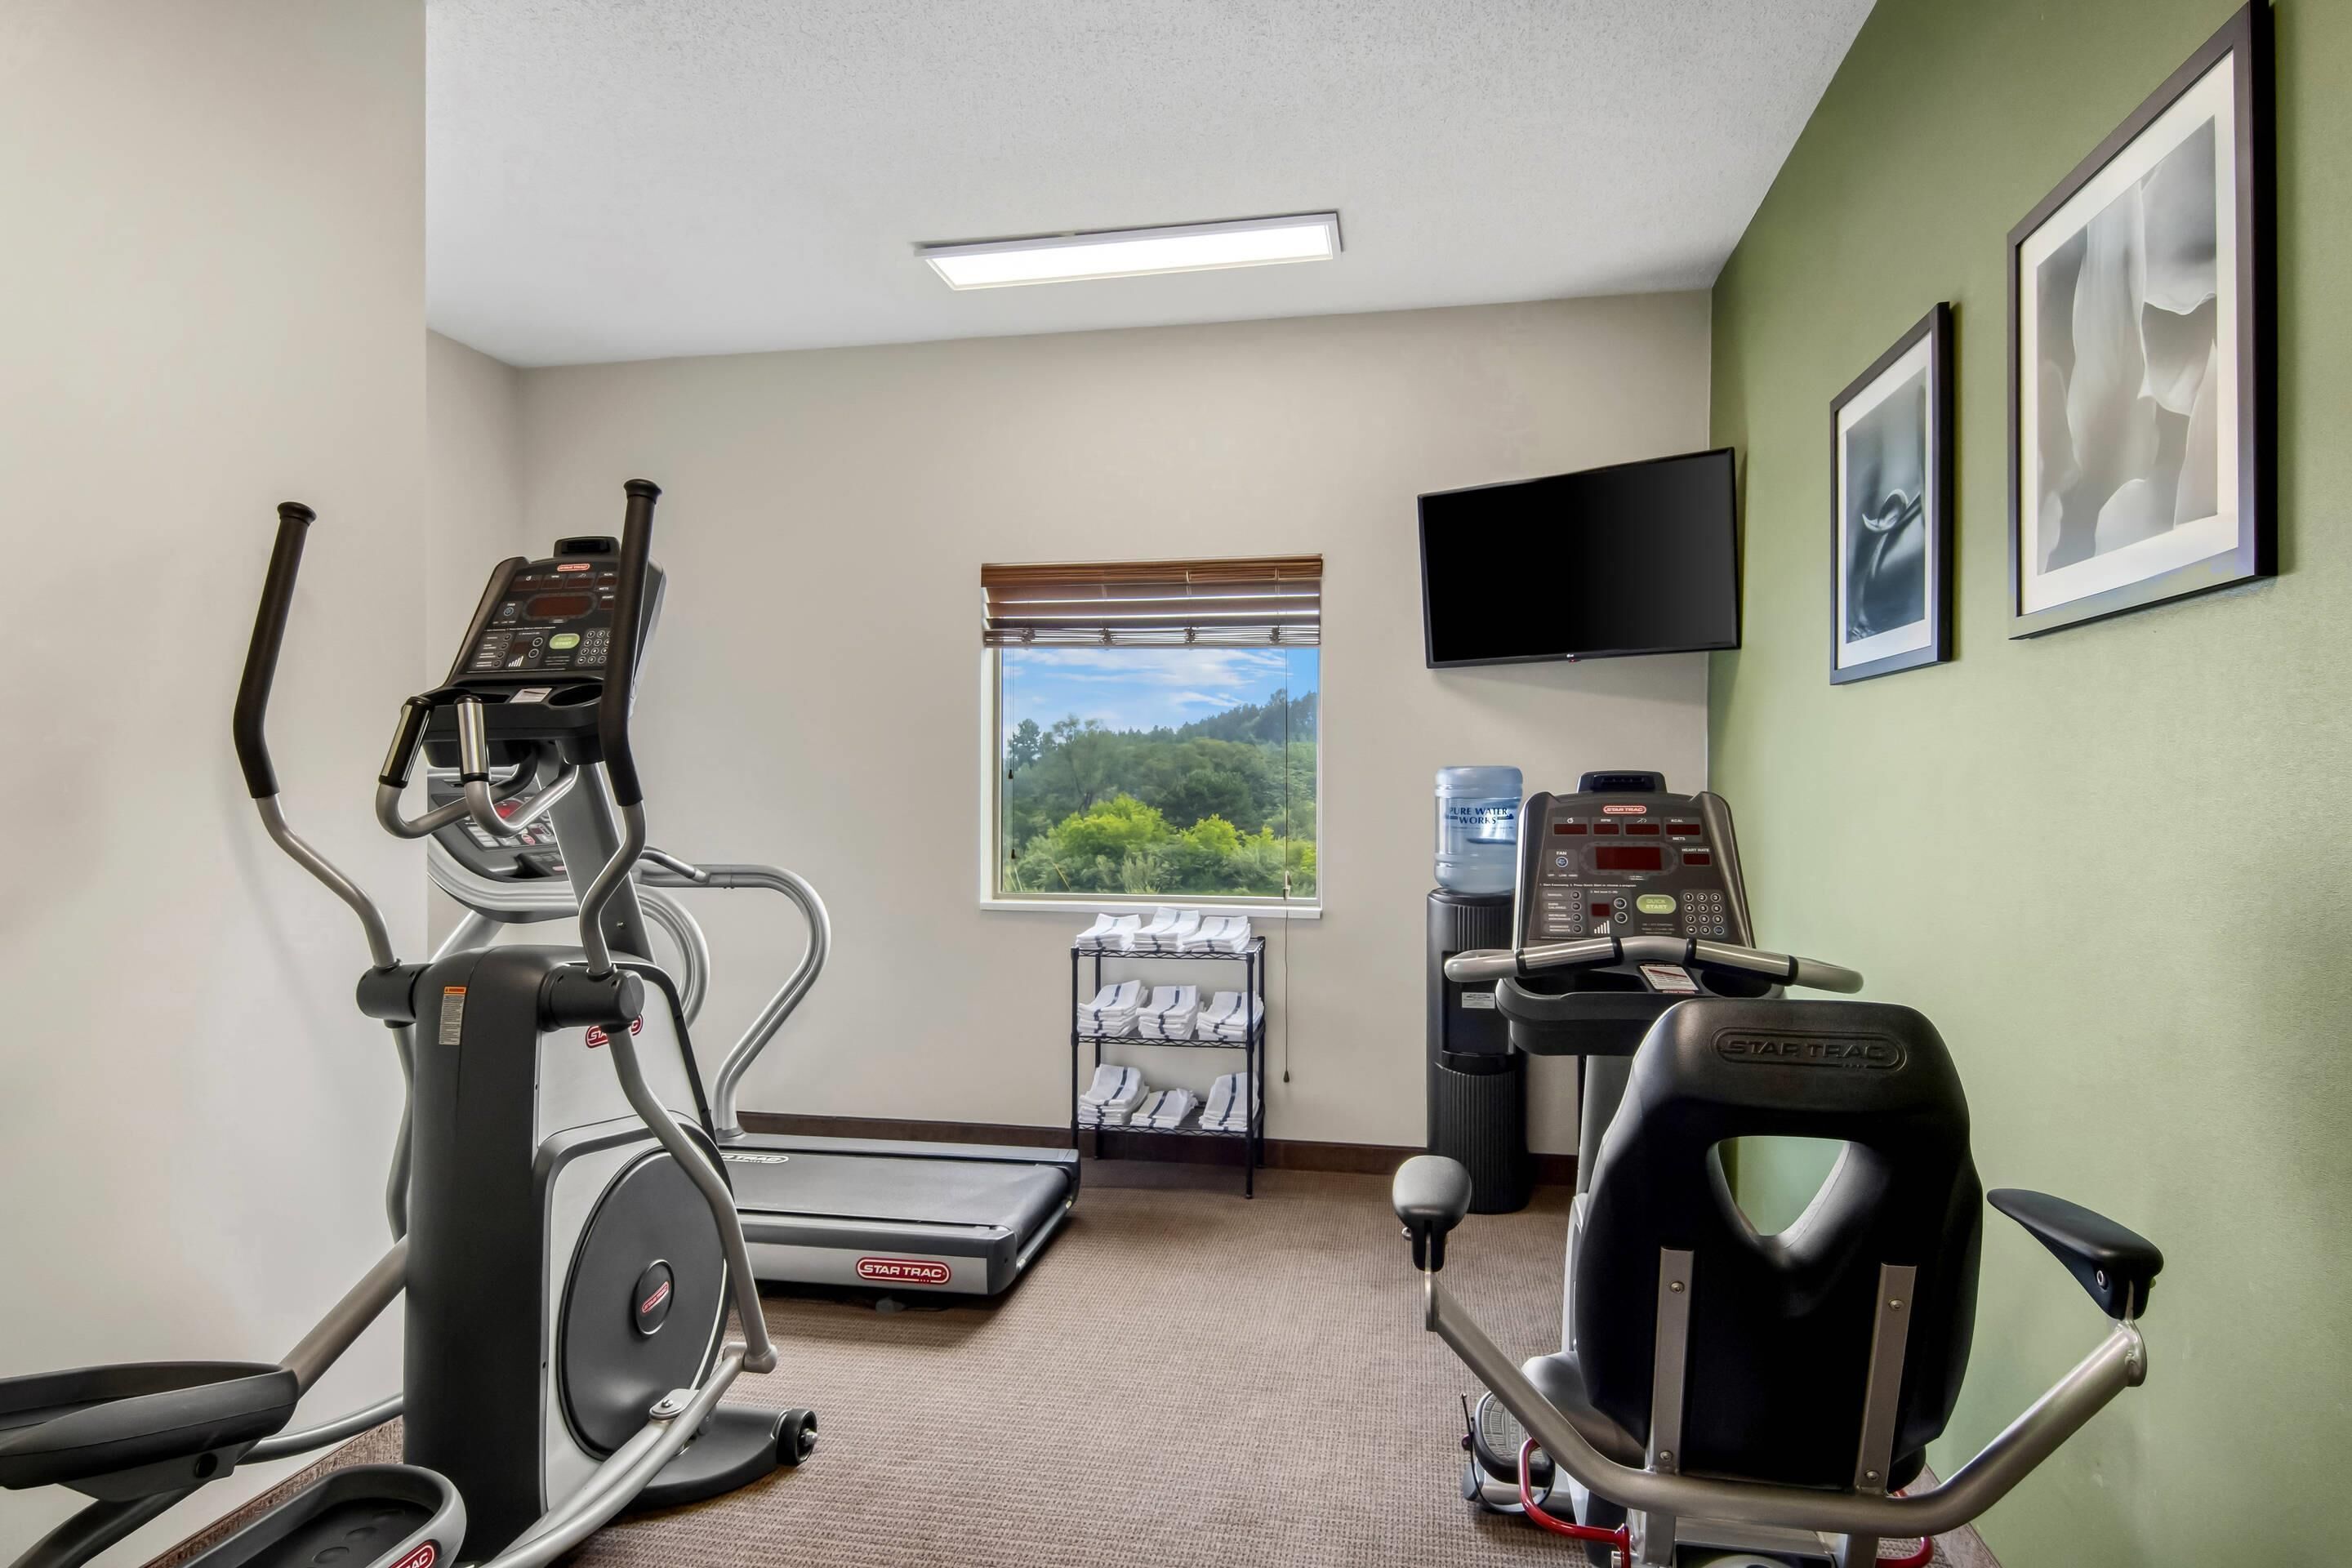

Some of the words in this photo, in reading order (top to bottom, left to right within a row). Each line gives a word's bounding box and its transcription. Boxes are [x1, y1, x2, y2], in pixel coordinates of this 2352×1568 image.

[1450, 807, 1472, 815] PURE
[1475, 807, 1508, 815] WATER
[1722, 1040, 1800, 1056] STAR
[1804, 1043, 1885, 1060] TRAC
[862, 1264, 900, 1275] STAR
[902, 1267, 942, 1278] TRAC
